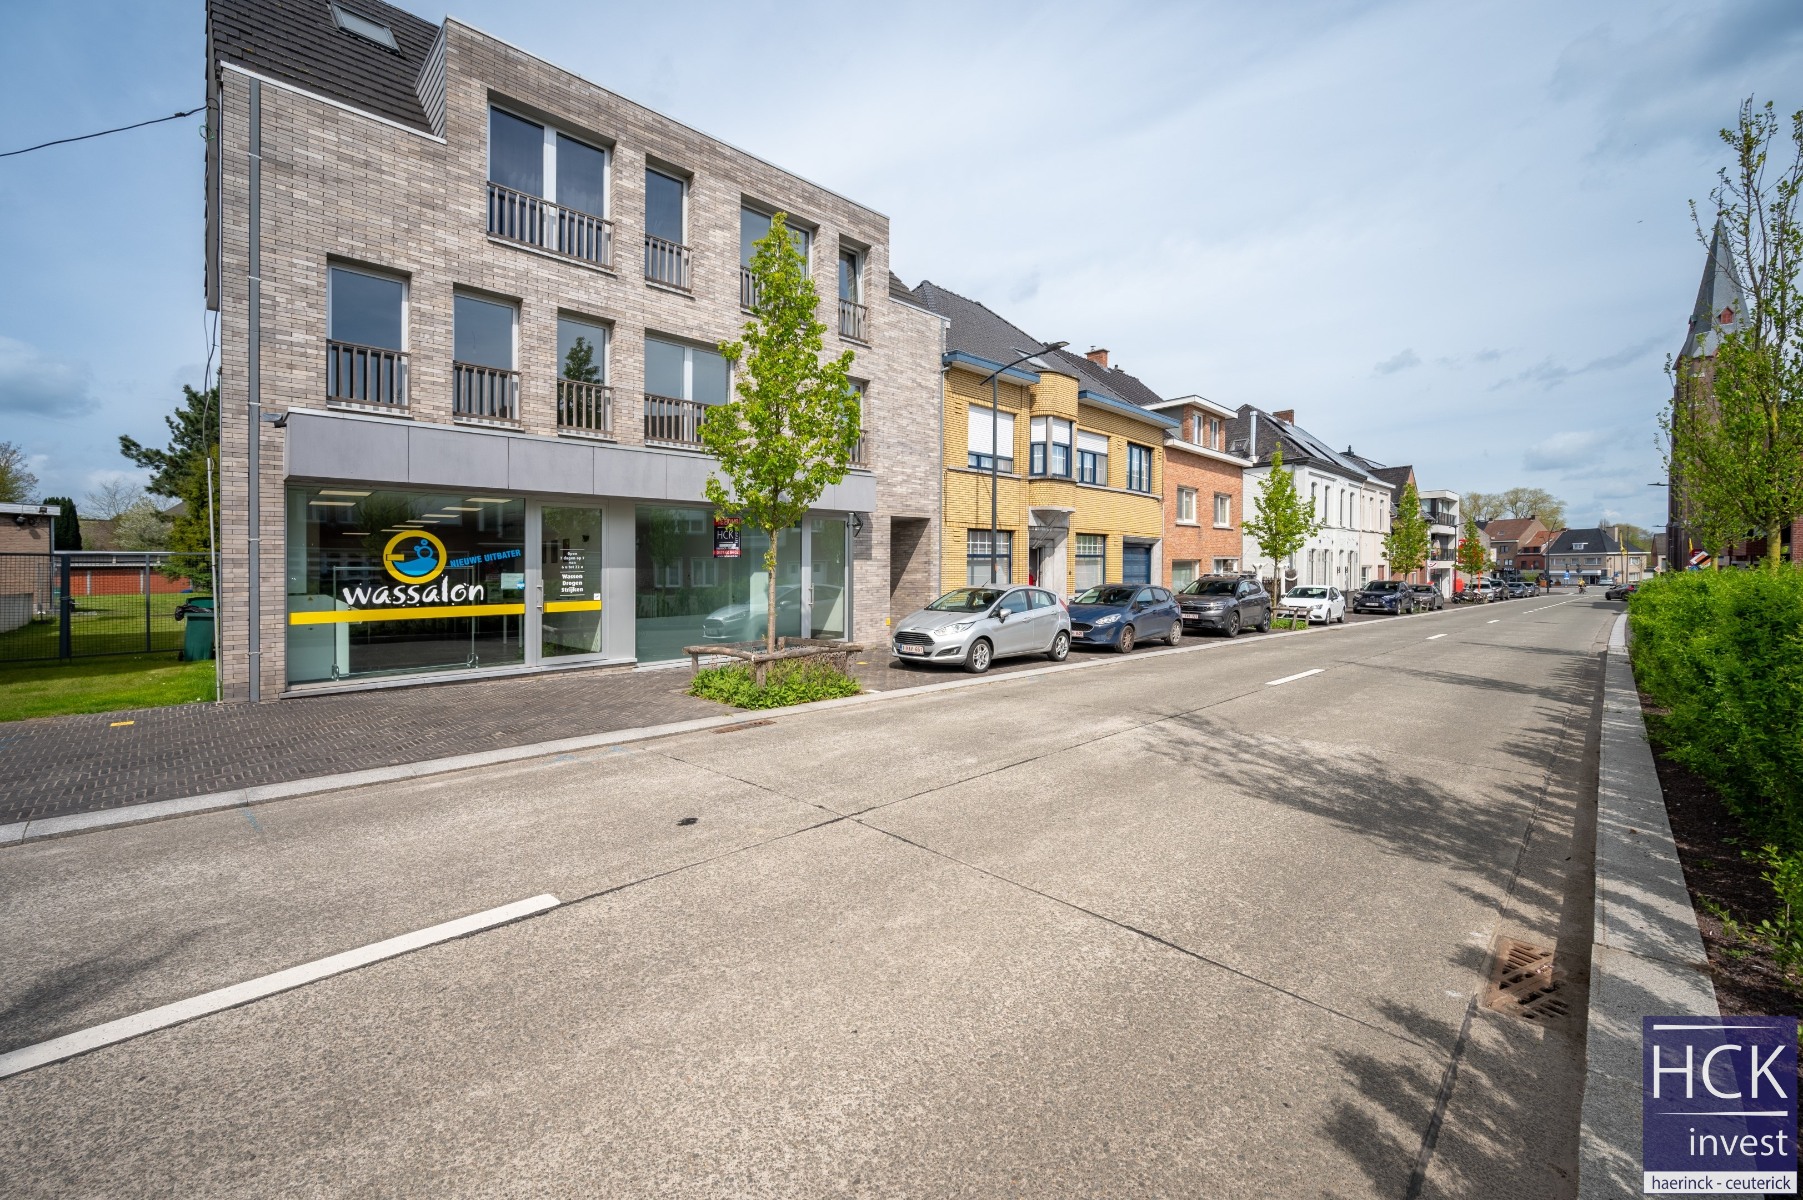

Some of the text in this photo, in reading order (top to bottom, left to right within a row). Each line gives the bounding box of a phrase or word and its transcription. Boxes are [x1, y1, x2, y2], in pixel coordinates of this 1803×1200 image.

[717, 530, 733, 539] HCK
[450, 549, 522, 568] NIEUWE UITBATER
[342, 575, 485, 606] wassalon
